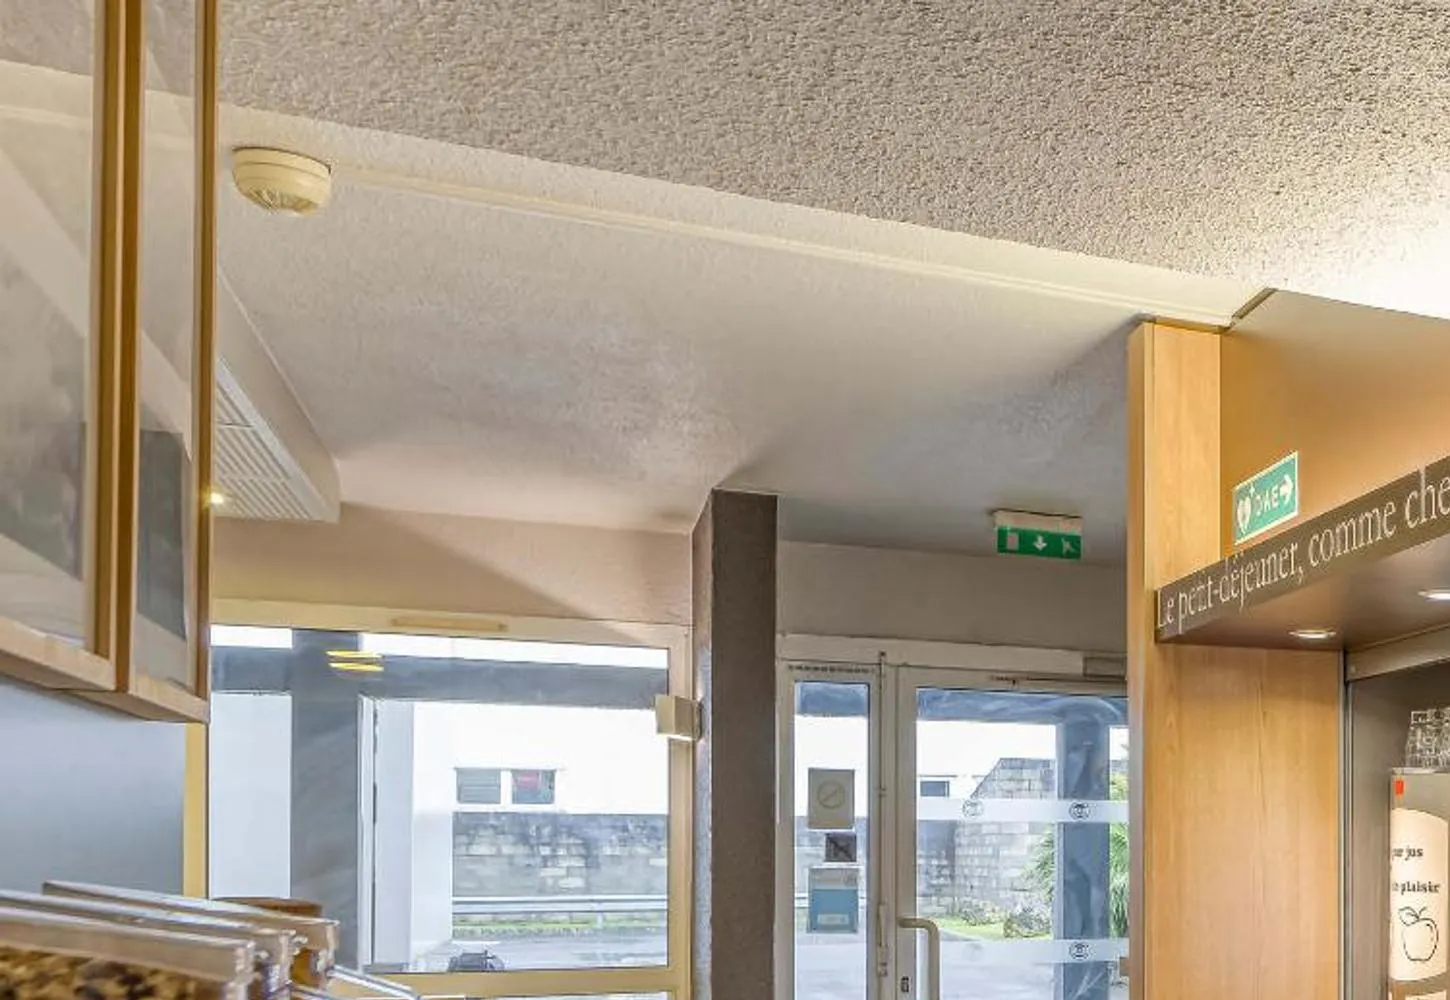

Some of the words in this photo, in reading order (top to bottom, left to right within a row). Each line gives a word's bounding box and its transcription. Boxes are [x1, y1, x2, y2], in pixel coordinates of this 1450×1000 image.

[1156, 588, 1175, 628] Le
[1308, 500, 1397, 568] comme
[1404, 845, 1424, 861] jus
